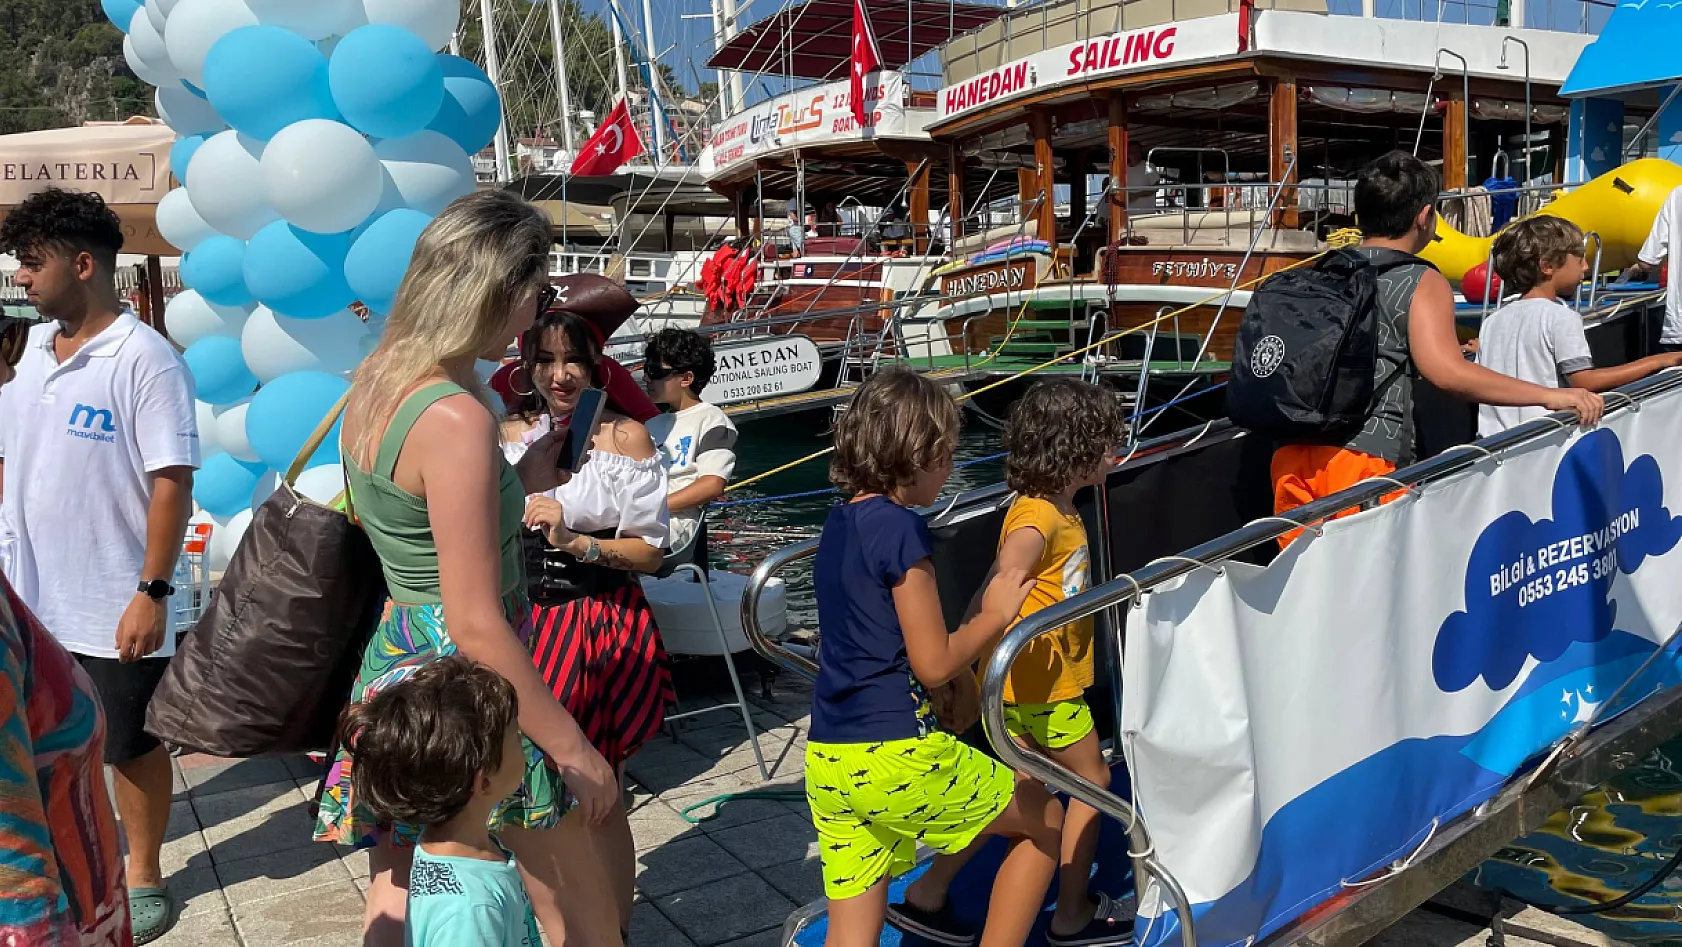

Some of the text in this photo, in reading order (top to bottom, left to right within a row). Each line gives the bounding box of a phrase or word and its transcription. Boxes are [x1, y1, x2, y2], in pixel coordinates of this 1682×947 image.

[945, 27, 1177, 115] HANEDAN SAILING
[832, 84, 886, 109] 12 INDS
[832, 111, 882, 133] BOAT RIP
[0, 163, 140, 180] ELATERIA
[947, 267, 1026, 296] HANEDAN
[754, 365, 788, 378] SAILING
[791, 361, 813, 373] BOAT
[723, 390, 729, 399] 0
[731, 387, 745, 398] 533
[1490, 508, 1640, 597] BİLGİ & REZERVASYON
[1518, 547, 1618, 608] 0553 245 3801
